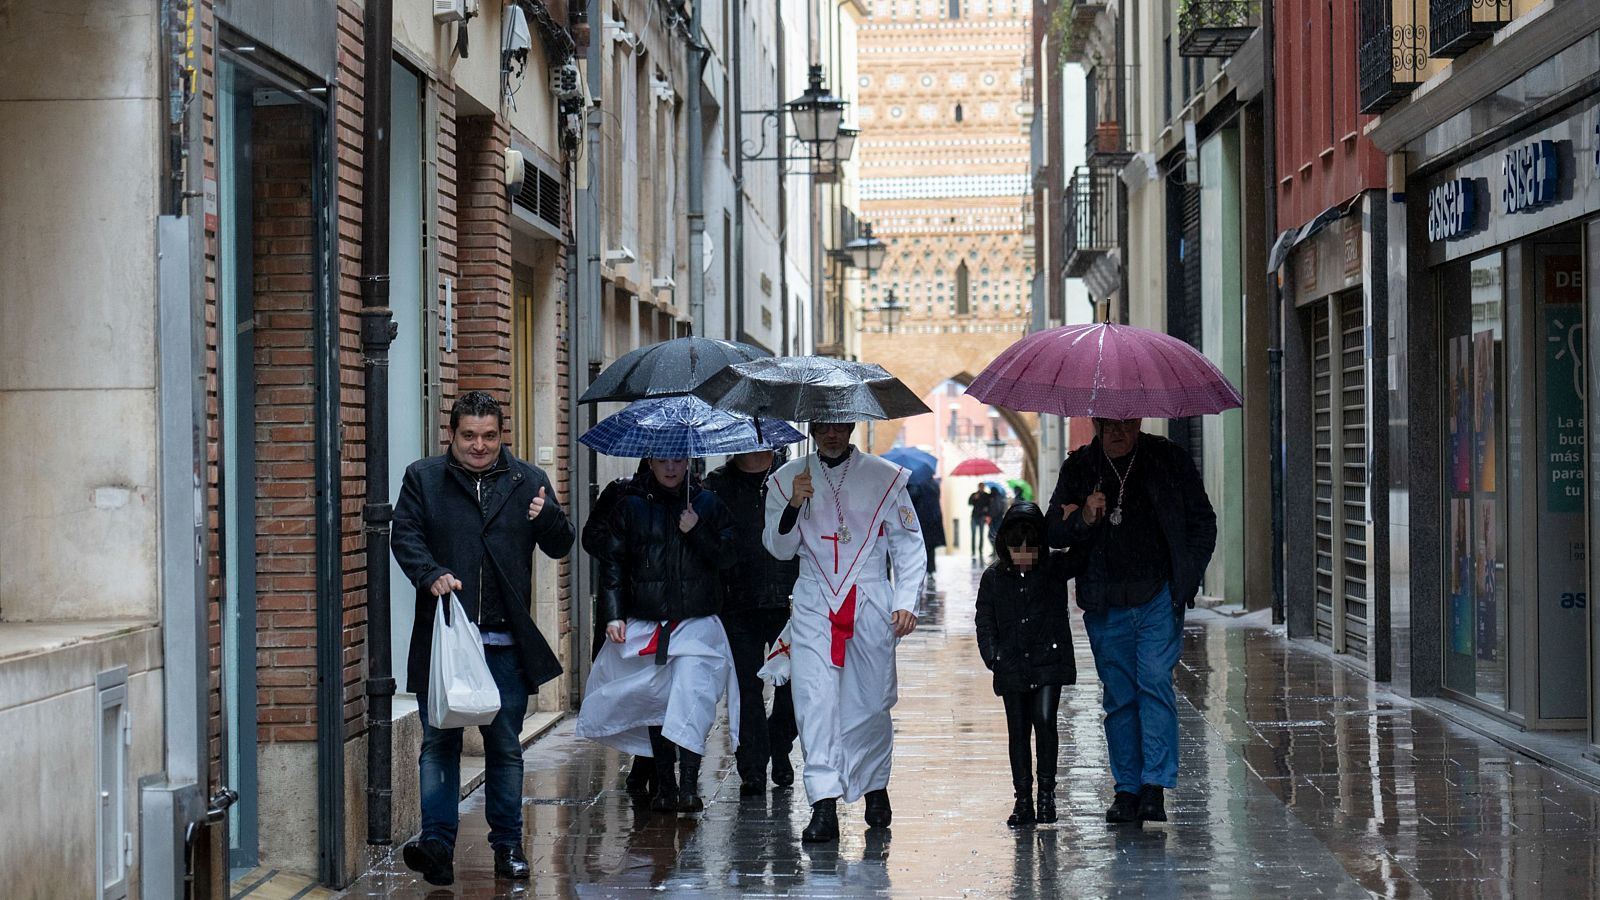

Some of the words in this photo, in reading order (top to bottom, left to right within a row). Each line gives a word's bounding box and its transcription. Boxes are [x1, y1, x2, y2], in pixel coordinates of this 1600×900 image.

[1502, 143, 1534, 215] asisa
[1428, 180, 1456, 243] asisa
[1558, 417, 1574, 428] La
[1551, 450, 1579, 462] más
[1552, 469, 1584, 482] para
[1565, 486, 1580, 496] tu
[1561, 592, 1586, 608] as
